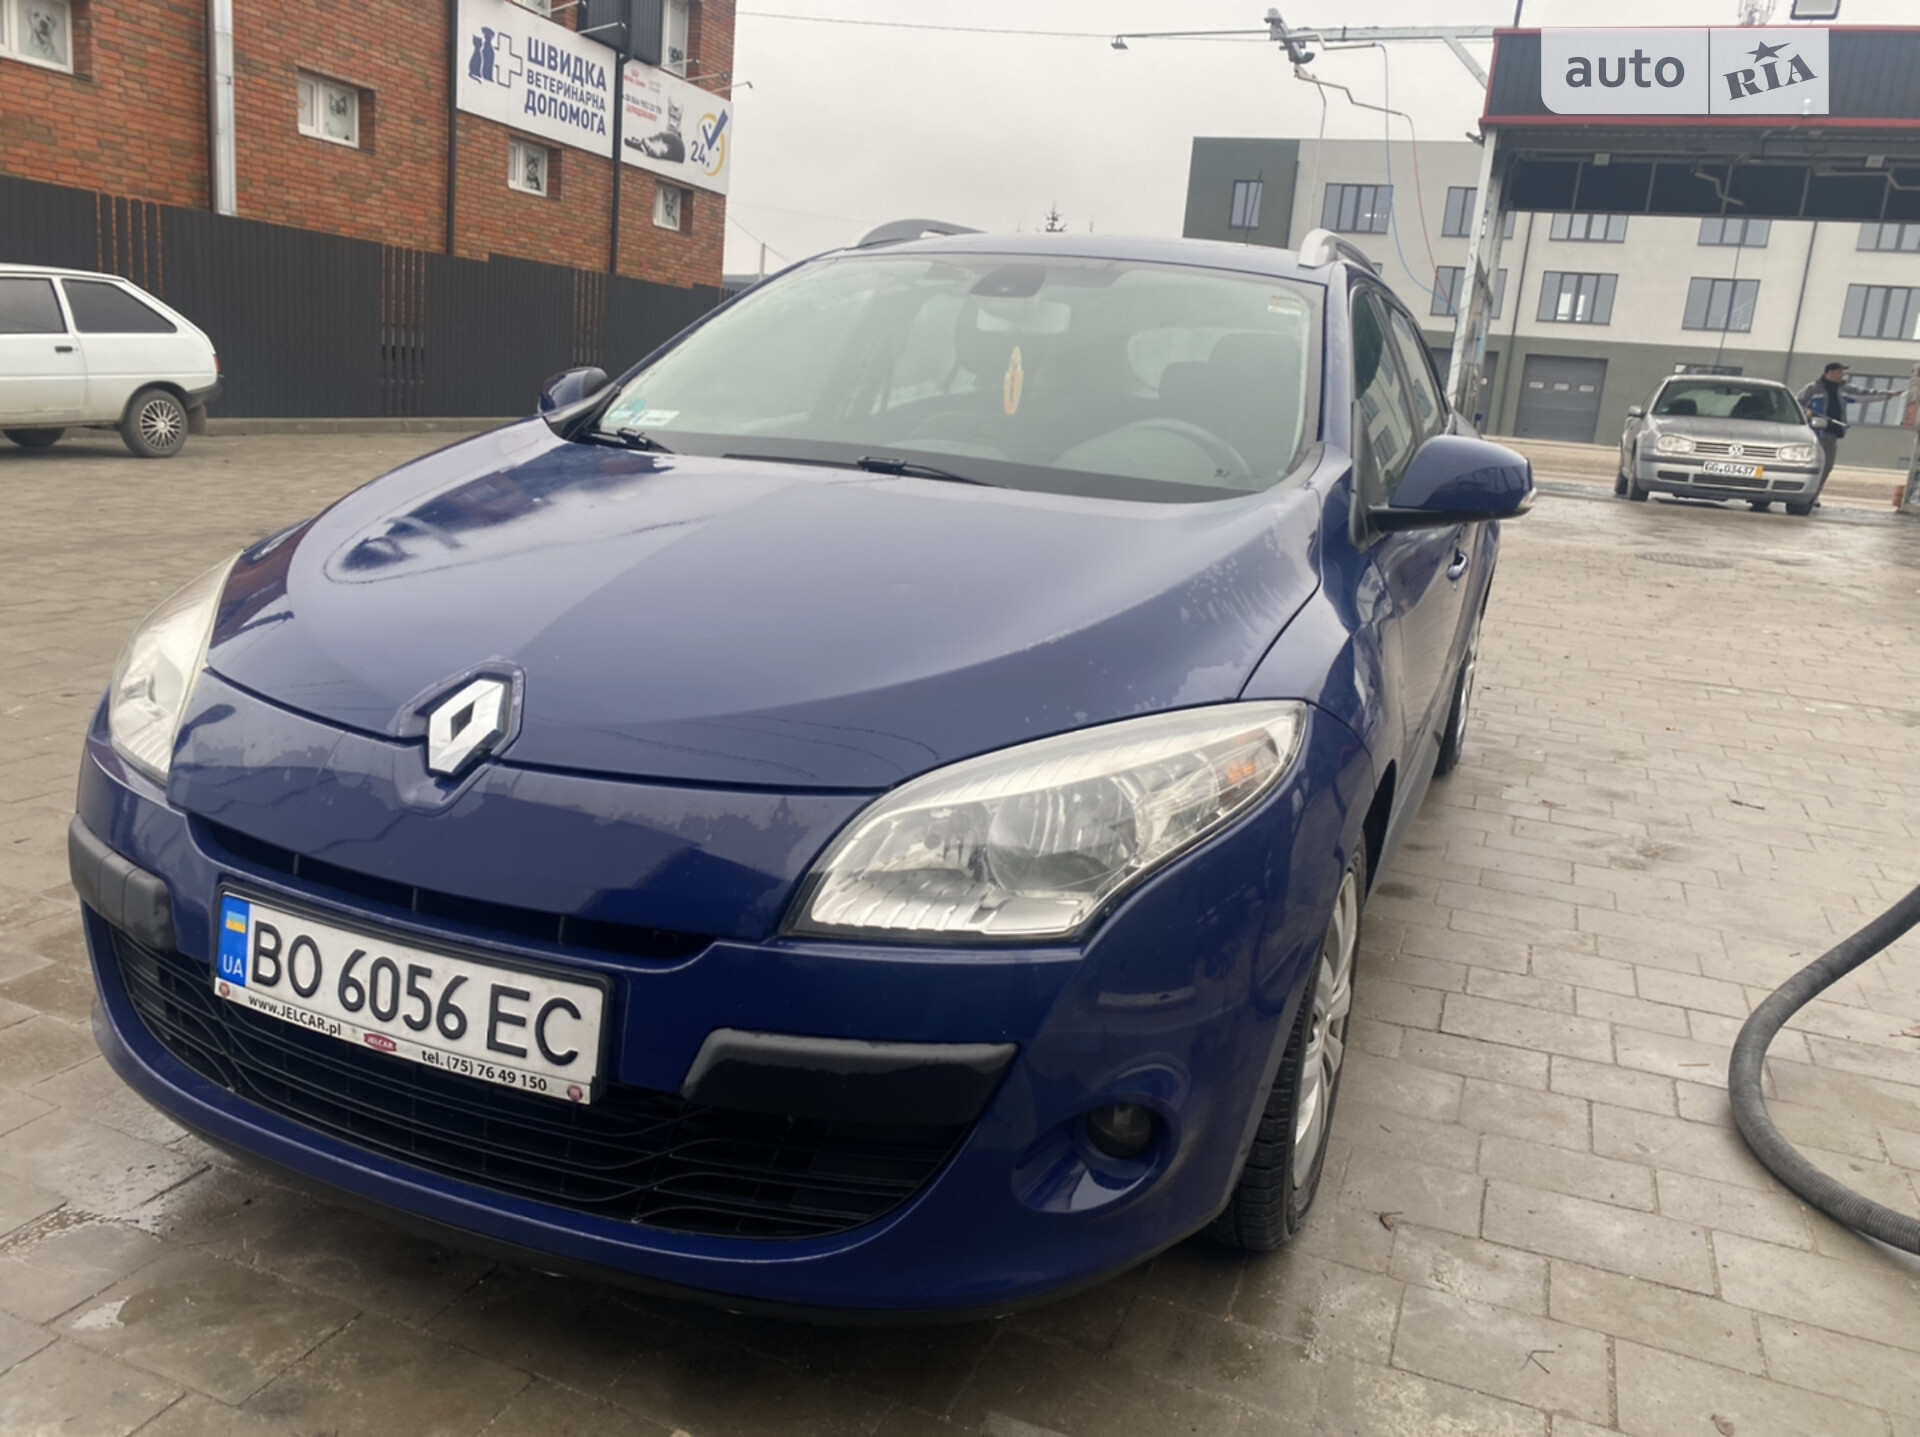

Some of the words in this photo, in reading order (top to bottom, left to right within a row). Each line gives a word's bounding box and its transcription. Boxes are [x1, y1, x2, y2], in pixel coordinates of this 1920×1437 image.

[527, 36, 607, 92] ШВИДКА
[524, 88, 606, 137] ДОПОМОГА
[527, 68, 606, 113] ВЕТЕРИНАРНА
[223, 954, 244, 979] UA
[251, 920, 323, 999] BO
[338, 949, 468, 1040] 6056
[487, 983, 582, 1066] EC
[248, 996, 342, 1037] www.JELCAR.pl
[421, 1050, 444, 1066] tel.
[446, 1055, 474, 1075] (75)
[477, 1063, 495, 1079] 76
[498, 1069, 517, 1084] 49
[520, 1074, 547, 1091] 150
